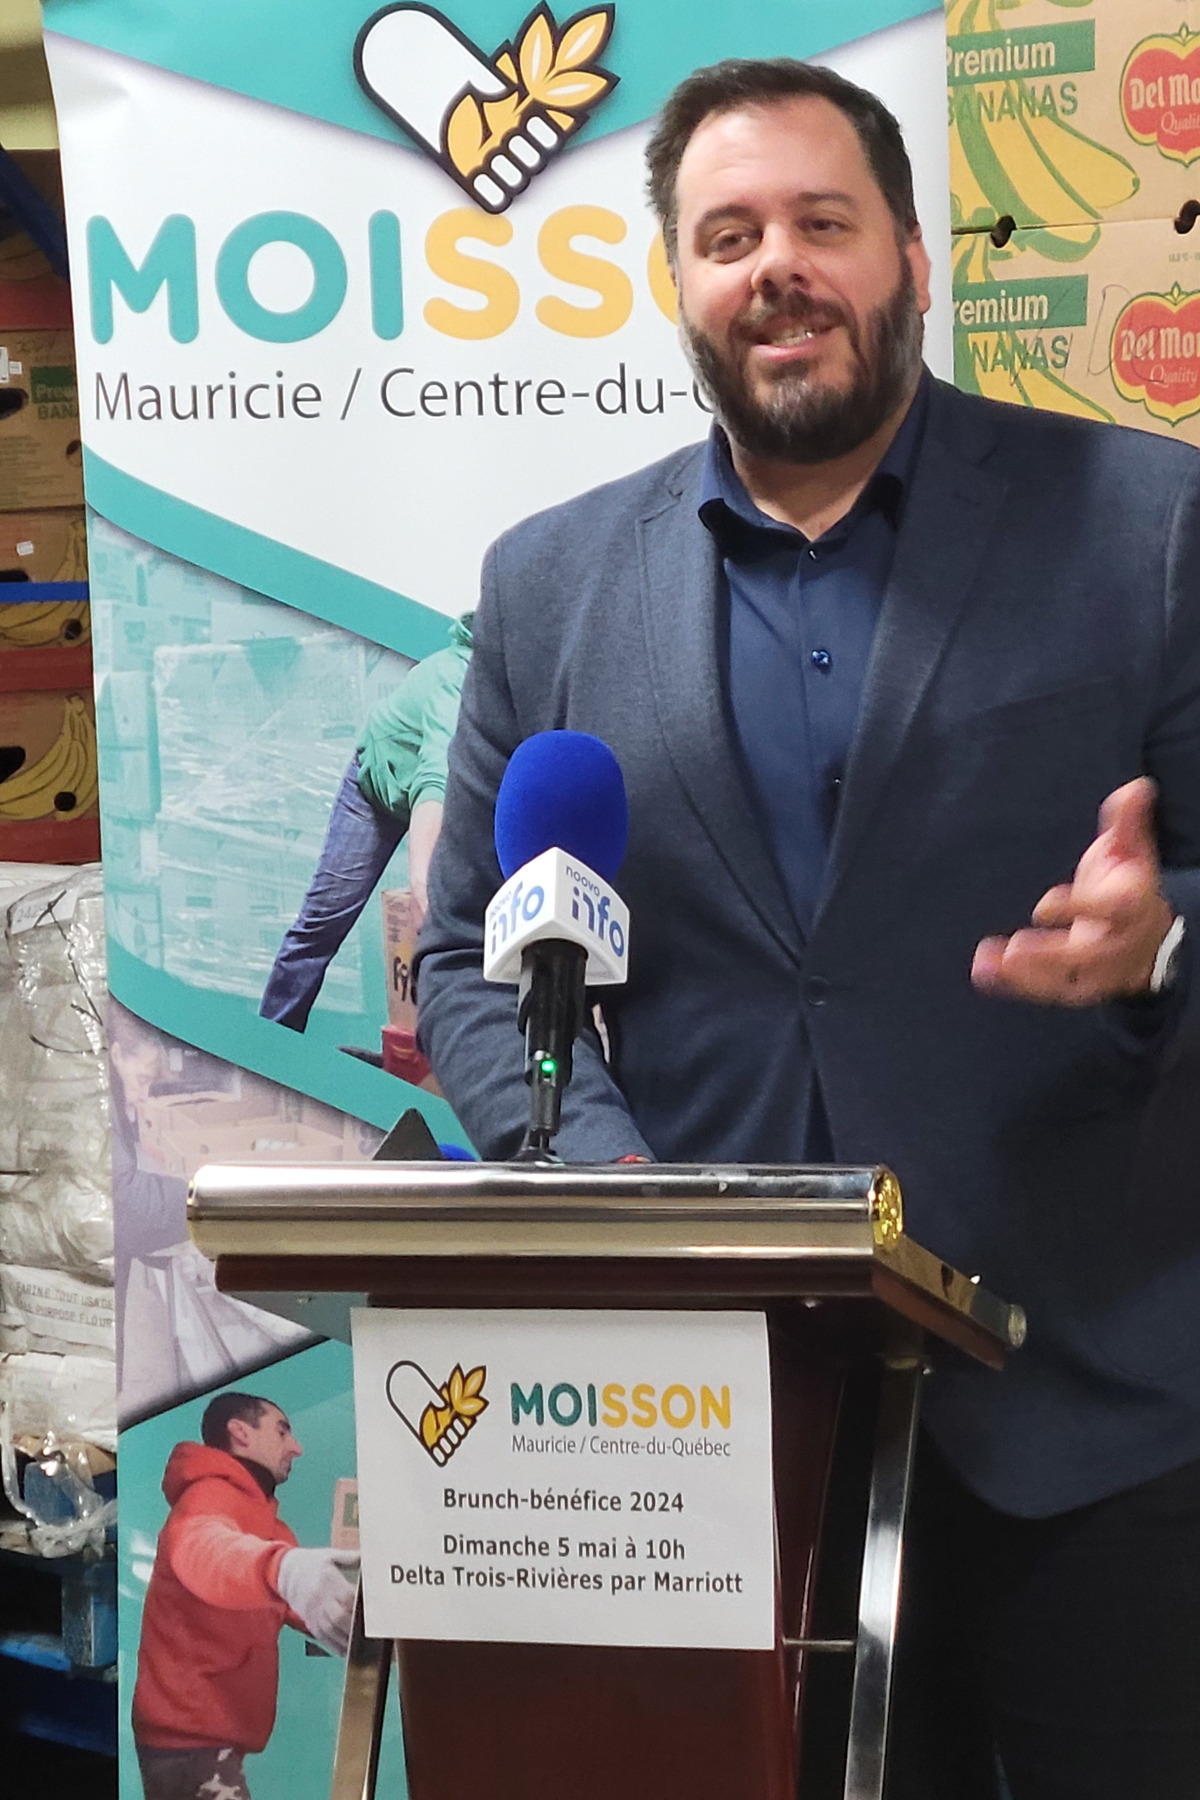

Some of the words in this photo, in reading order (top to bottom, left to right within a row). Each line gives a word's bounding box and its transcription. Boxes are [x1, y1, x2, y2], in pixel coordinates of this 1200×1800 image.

[1129, 76, 1165, 112] Del
[86, 205, 687, 345] MOISS
[1120, 329, 1156, 363] Del
[1150, 364, 1199, 389] Quality
[94, 369, 322, 421] Mauricie
[340, 368, 362, 421] /
[565, 865, 601, 898] noovo
[571, 886, 625, 958] info
[510, 1382, 732, 1430] MOISSON
[511, 1435, 576, 1454] Mauricie
[579, 1436, 587, 1455] /
[589, 1435, 731, 1457] Centre-du-Québec
[443, 1487, 622, 1512] Brunch-bénéfice
[629, 1491, 685, 1513] 2024
[443, 1534, 551, 1557] Dimanche
[557, 1537, 570, 1558] 5
[578, 1537, 618, 1559] mai
[624, 1536, 637, 1560] à
[646, 1538, 686, 1561] 10h
[390, 1565, 446, 1586] Delta
[452, 1566, 604, 1591] Trois-Rivières
[610, 1575, 647, 1596] par
[653, 1572, 744, 1593] Marriott
